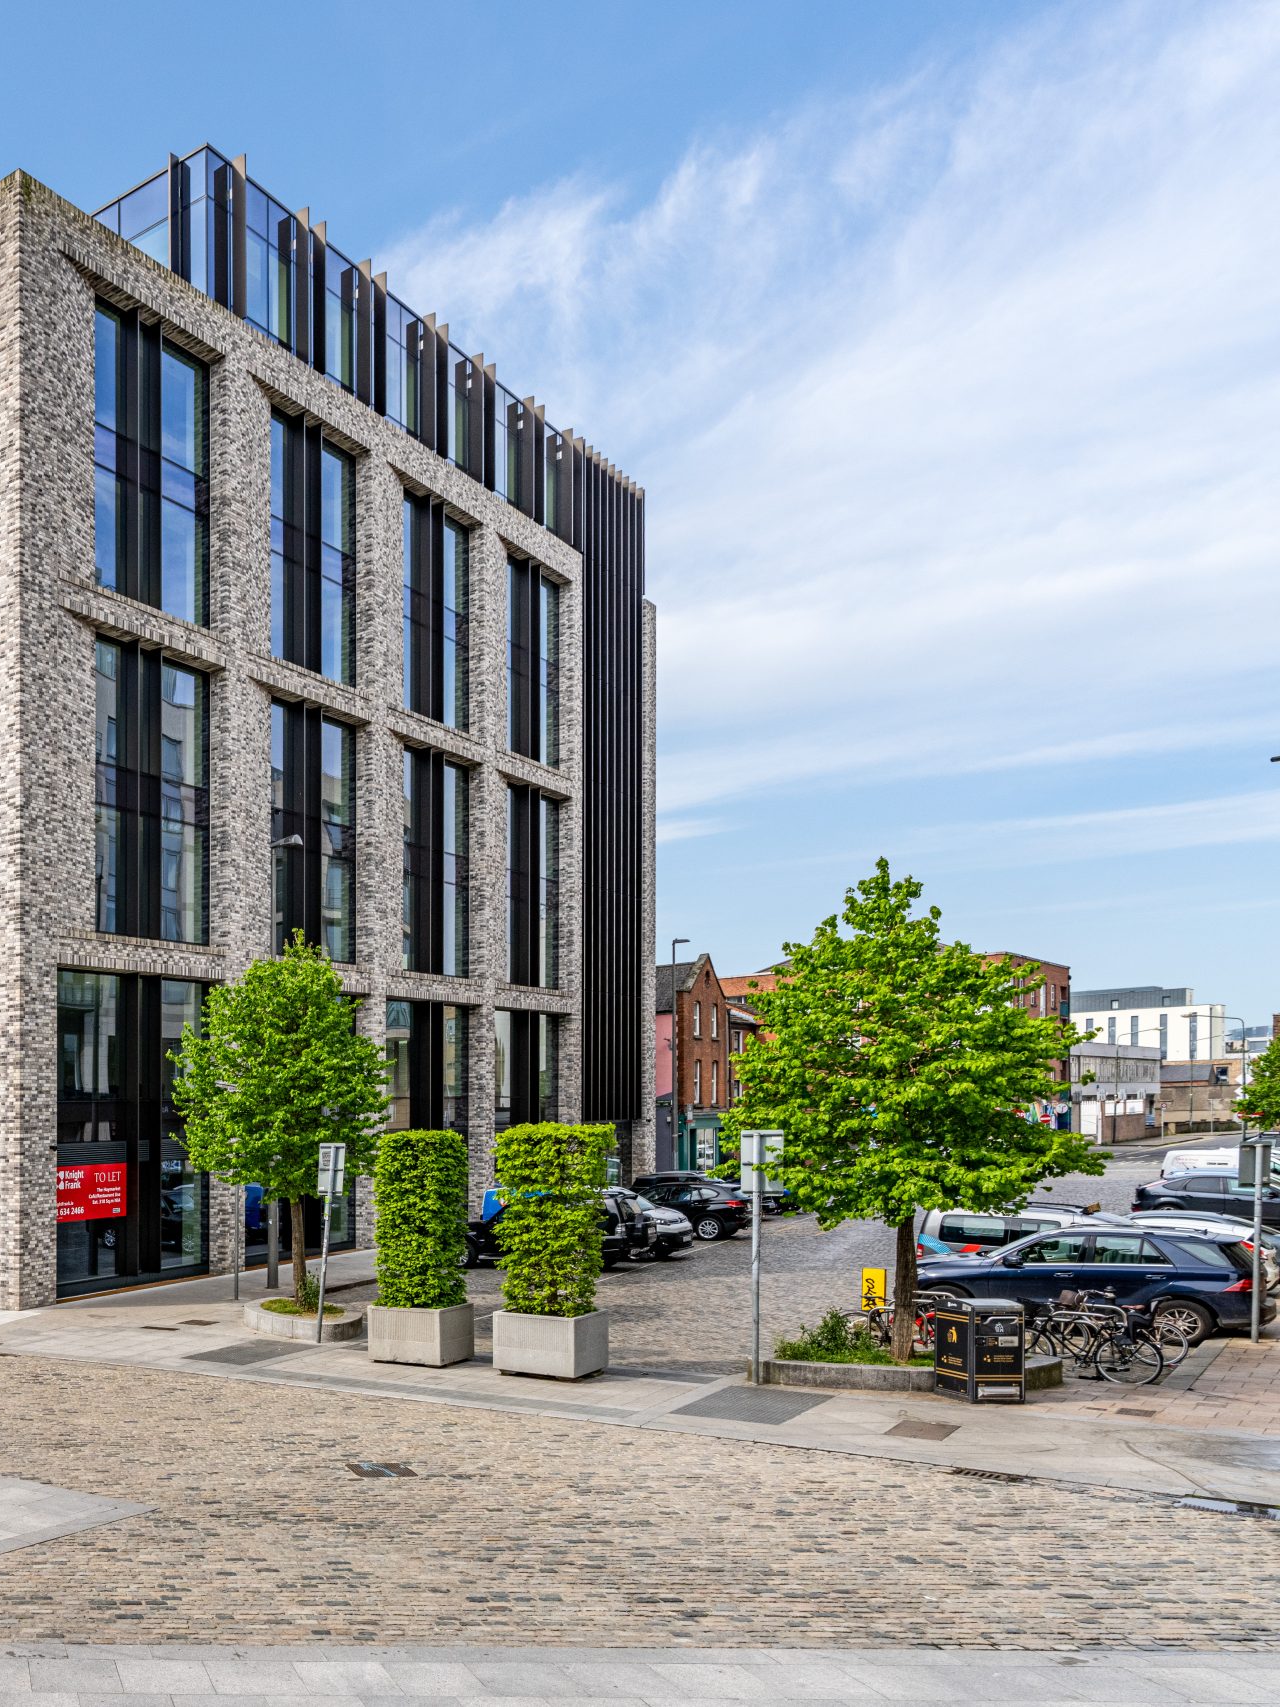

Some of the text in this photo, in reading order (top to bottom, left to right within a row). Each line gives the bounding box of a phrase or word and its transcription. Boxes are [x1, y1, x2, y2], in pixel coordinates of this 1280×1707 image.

[65, 1170, 84, 1181] Knight
[94, 1171, 121, 1183] TO LET
[65, 1180, 81, 1190] Frank
[71, 1207, 84, 1215] 2466
